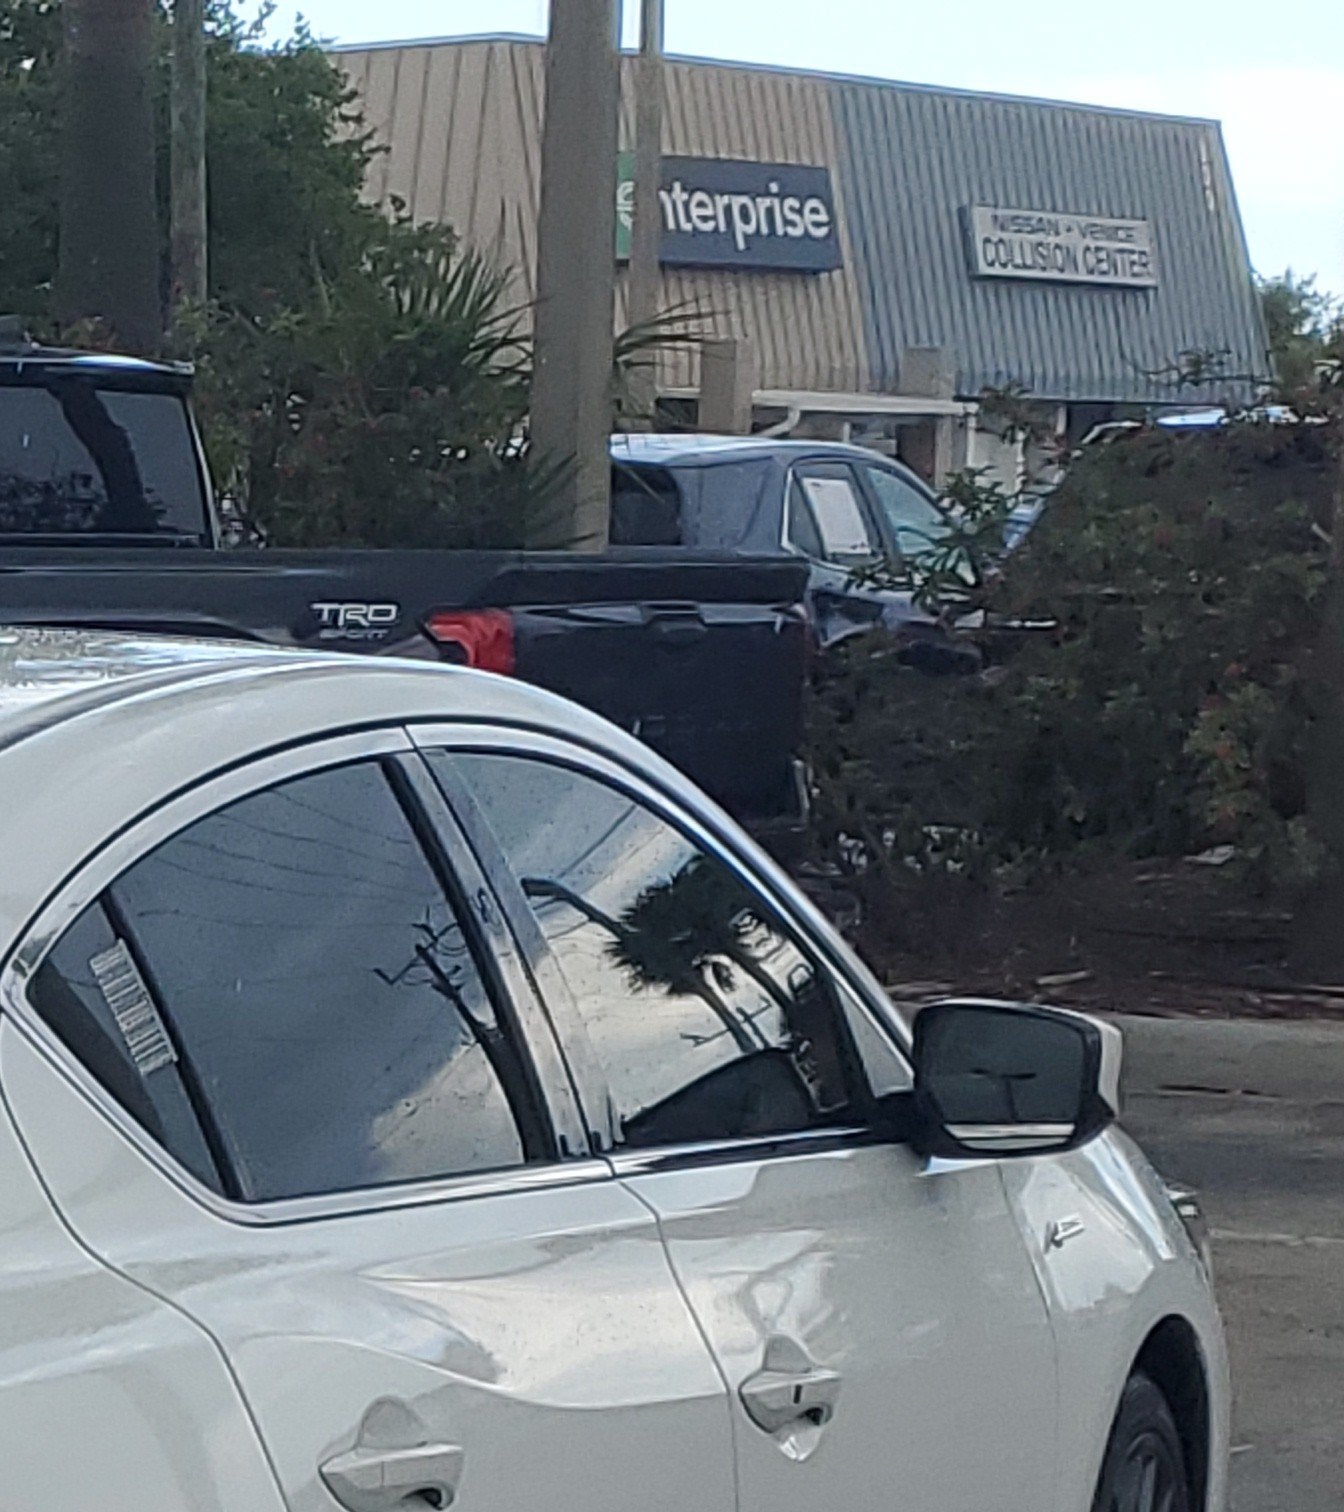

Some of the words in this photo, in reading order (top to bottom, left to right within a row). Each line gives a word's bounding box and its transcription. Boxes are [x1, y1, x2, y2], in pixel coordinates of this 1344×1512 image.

[982, 235, 1079, 276] COLLISION
[1081, 243, 1151, 279] CENTER
[311, 602, 399, 627] TRD
